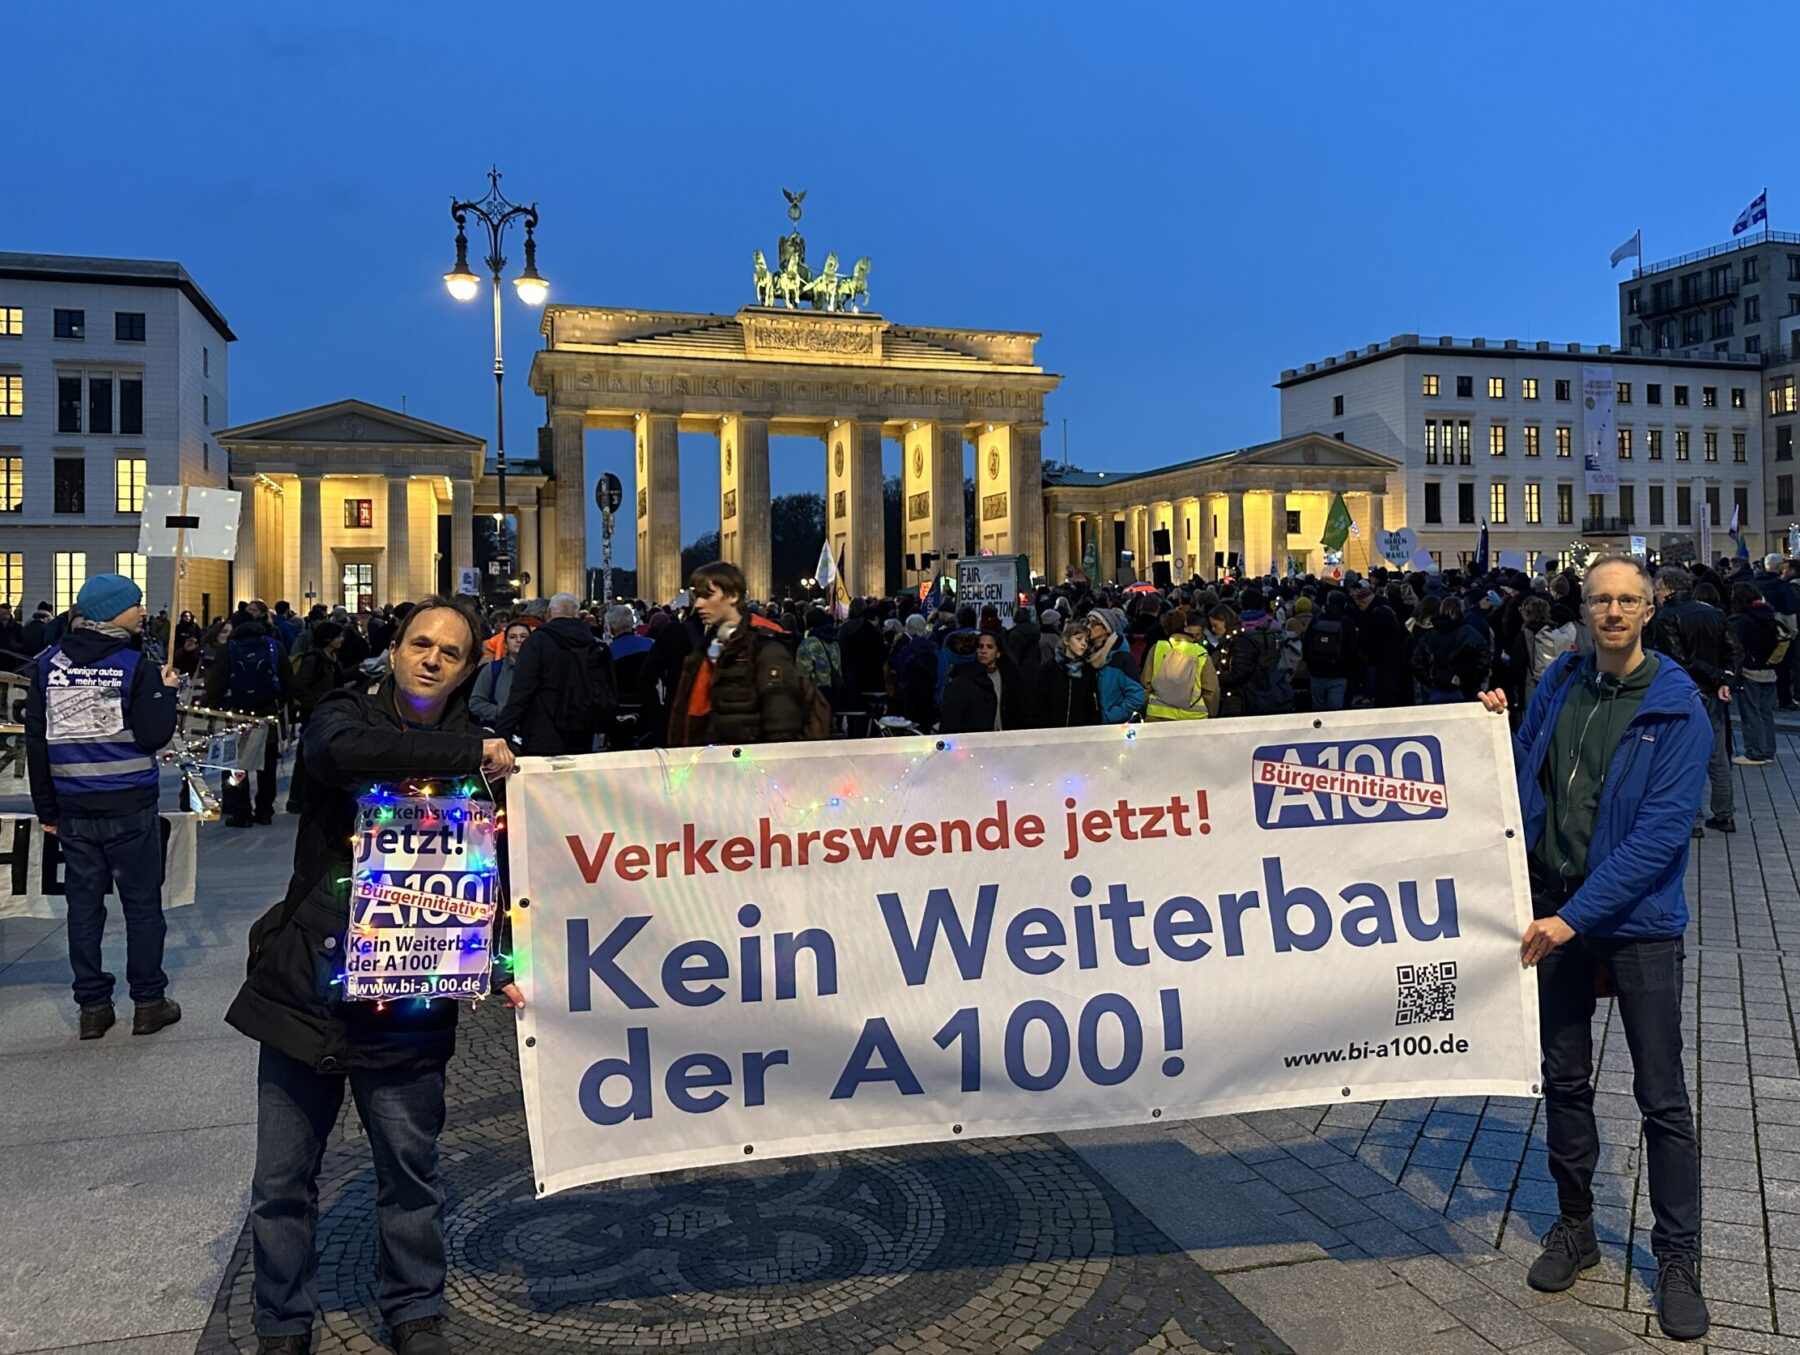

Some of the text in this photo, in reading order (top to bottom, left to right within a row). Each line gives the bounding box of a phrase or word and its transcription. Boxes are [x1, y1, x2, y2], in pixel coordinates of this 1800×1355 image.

[961, 567, 981, 583] FAIR
[961, 584, 1003, 601] BEWEGEN
[67, 666, 124, 677] weniger autos
[75, 677, 122, 687] mehr berlin
[1261, 763, 1443, 805] Bürgerinitiative
[1266, 741, 1434, 824] A100
[357, 820, 465, 863] jetzt!
[565, 789, 1212, 883] Verkehrswende jetzt!
[360, 873, 485, 926] A100
[361, 882, 487, 917] Bürgerinitiative
[350, 935, 488, 953] Kein Weiterbau
[566, 856, 1461, 1012] Kein Weiterbau
[348, 954, 438, 972] der A100!
[578, 988, 1185, 1126] der A100!
[1283, 1033, 1469, 1068] www.bi-a100.de
